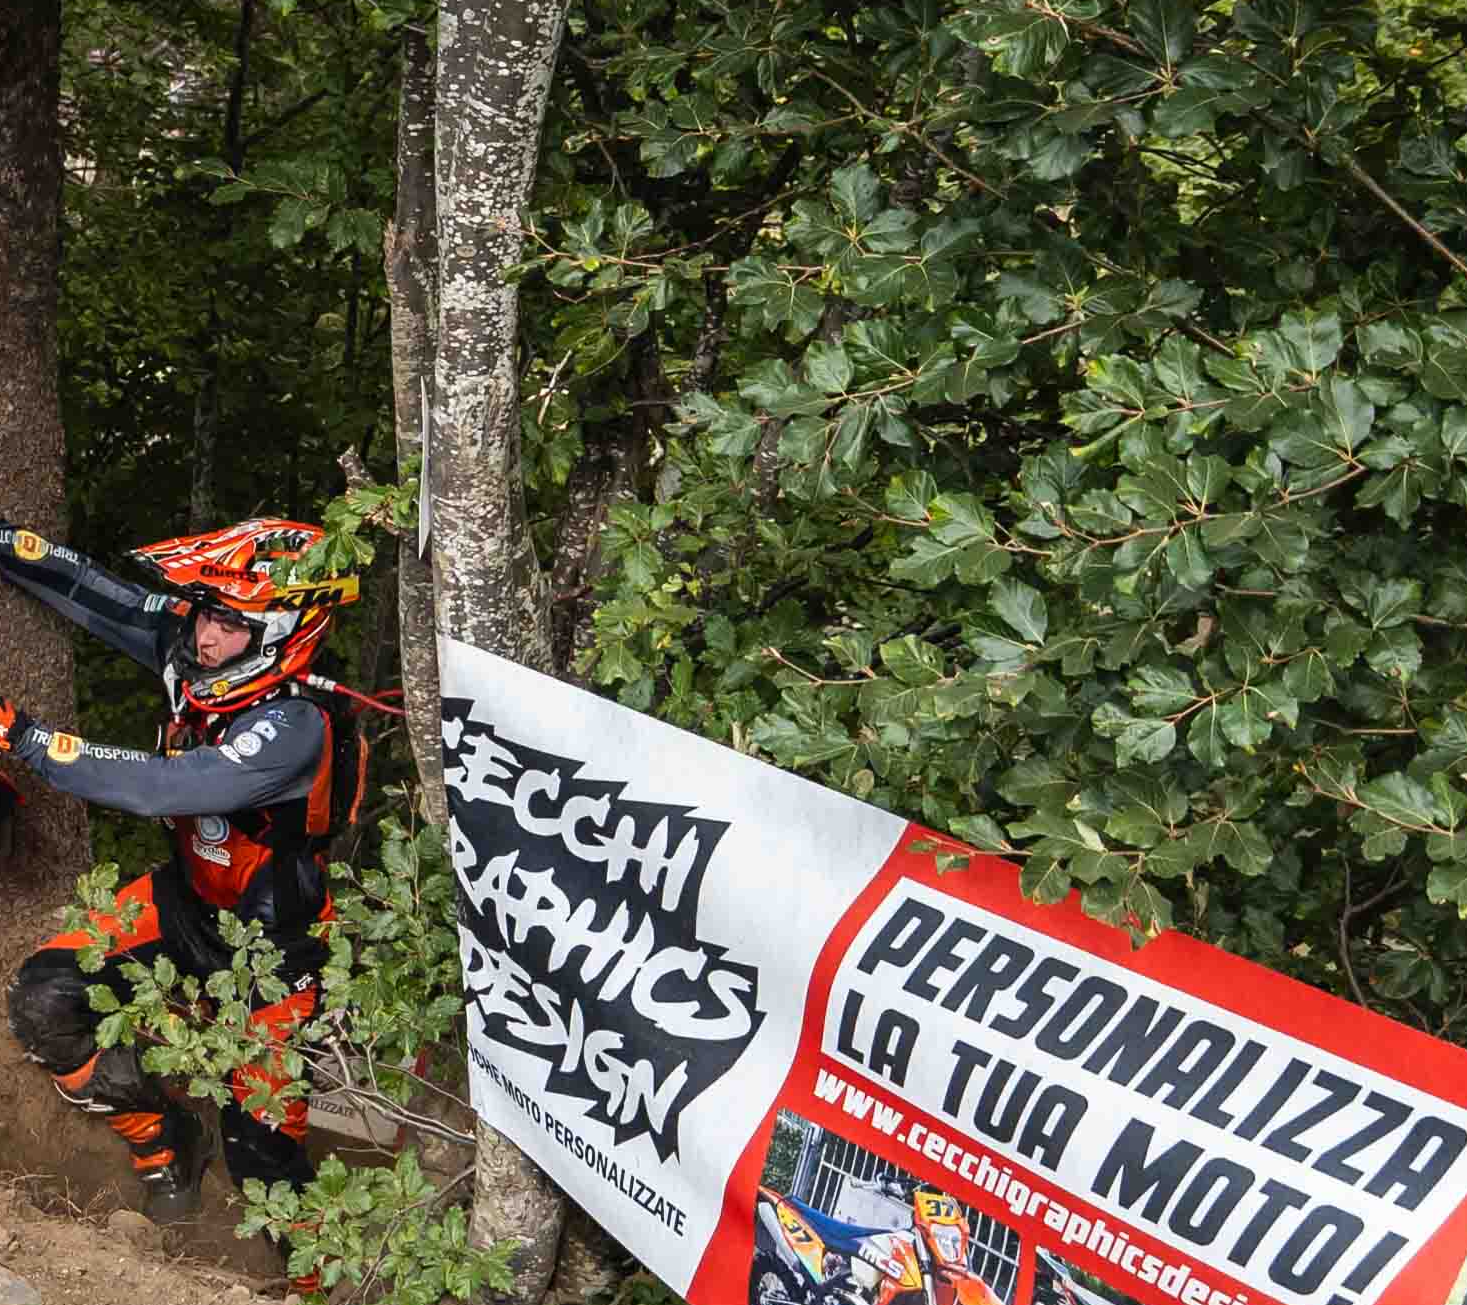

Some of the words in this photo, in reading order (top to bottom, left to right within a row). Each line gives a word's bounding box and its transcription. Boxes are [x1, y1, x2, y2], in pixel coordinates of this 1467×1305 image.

[449, 815, 753, 1040] RAPHICS
[500, 1073, 541, 1124] MOTO
[544, 1111, 687, 1237] PERSONALIZZATE
[837, 991, 920, 1087] LA
[942, 1038, 1089, 1172] TUA
[926, 1199, 954, 1217] 37
